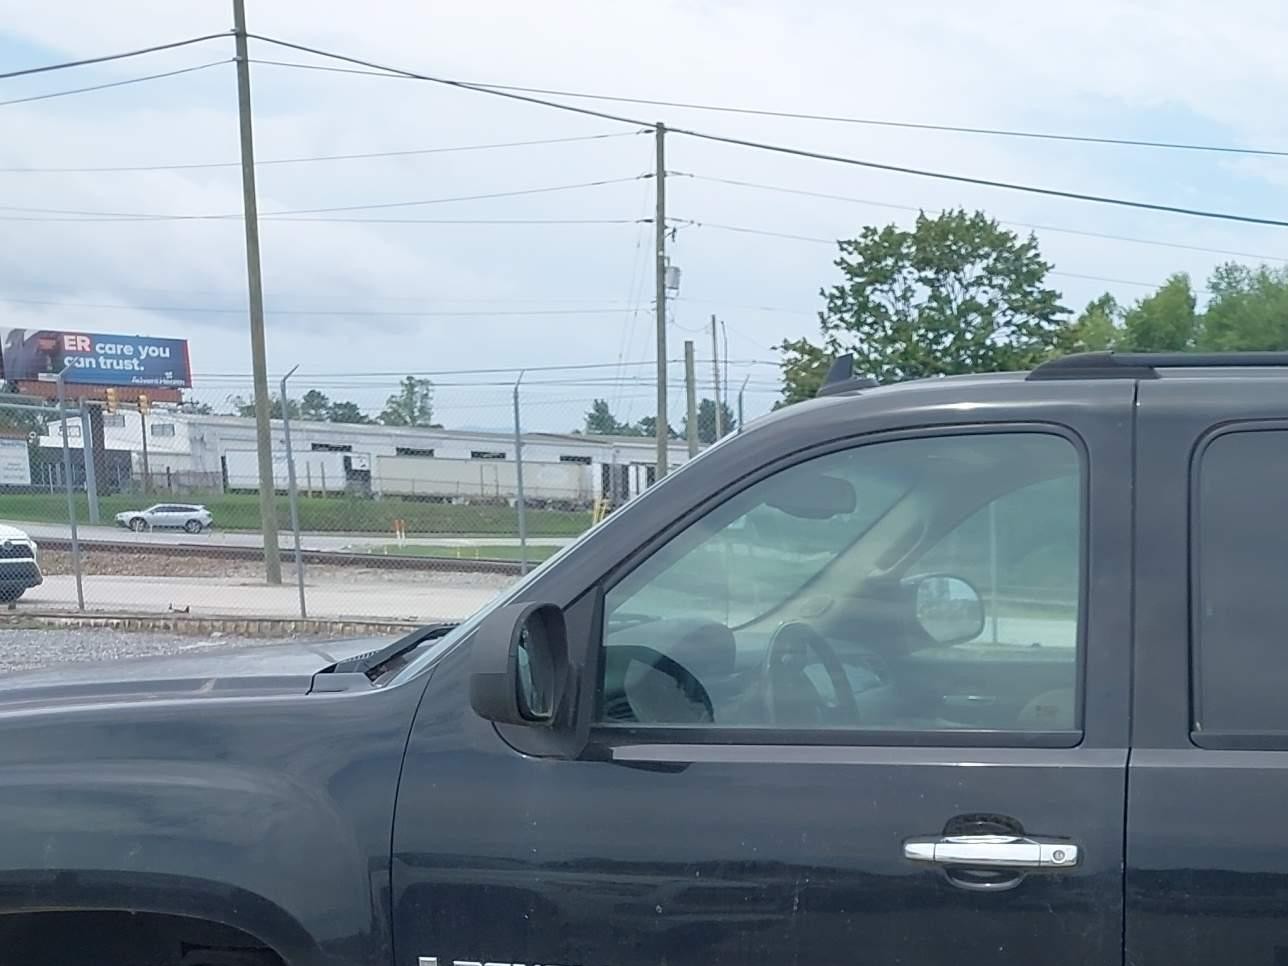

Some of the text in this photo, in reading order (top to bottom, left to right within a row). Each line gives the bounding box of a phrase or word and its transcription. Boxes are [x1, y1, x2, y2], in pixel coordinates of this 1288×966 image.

[64, 335, 170, 359] ER care you
[64, 355, 145, 371] can trust.
